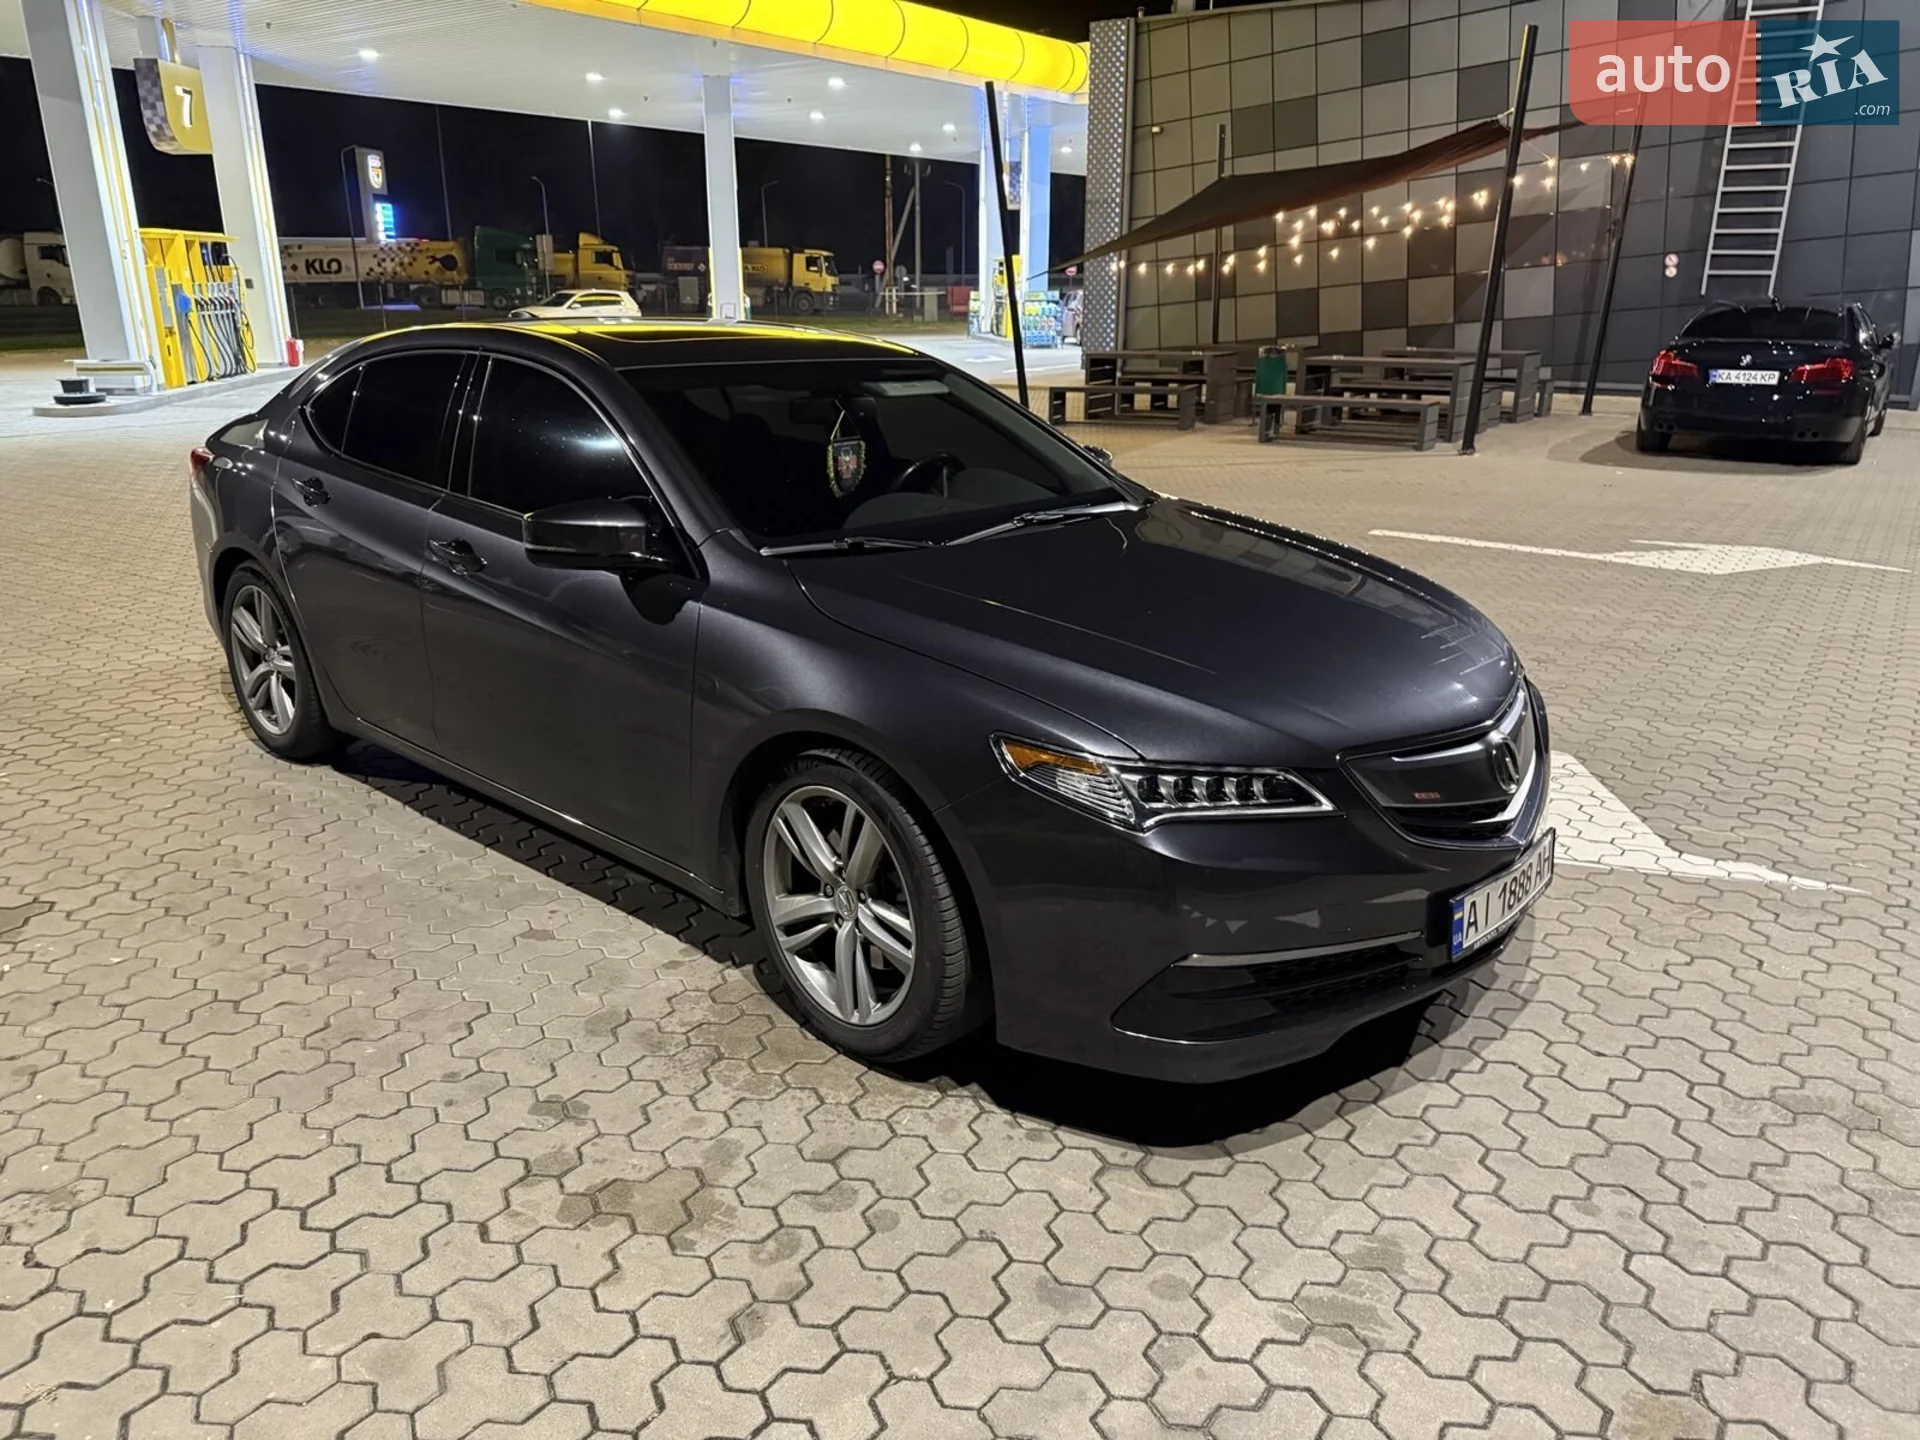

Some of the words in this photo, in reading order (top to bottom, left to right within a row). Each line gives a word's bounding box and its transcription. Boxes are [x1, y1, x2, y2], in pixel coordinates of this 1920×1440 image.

[174, 84, 193, 128] 7
[305, 258, 343, 275] KLO
[1717, 372, 1732, 381] KA
[1734, 372, 1759, 382] 4124
[1760, 373, 1776, 382] KP
[1465, 891, 1490, 940] AI
[1498, 861, 1533, 917] 1888
[1534, 840, 1551, 887] AH
